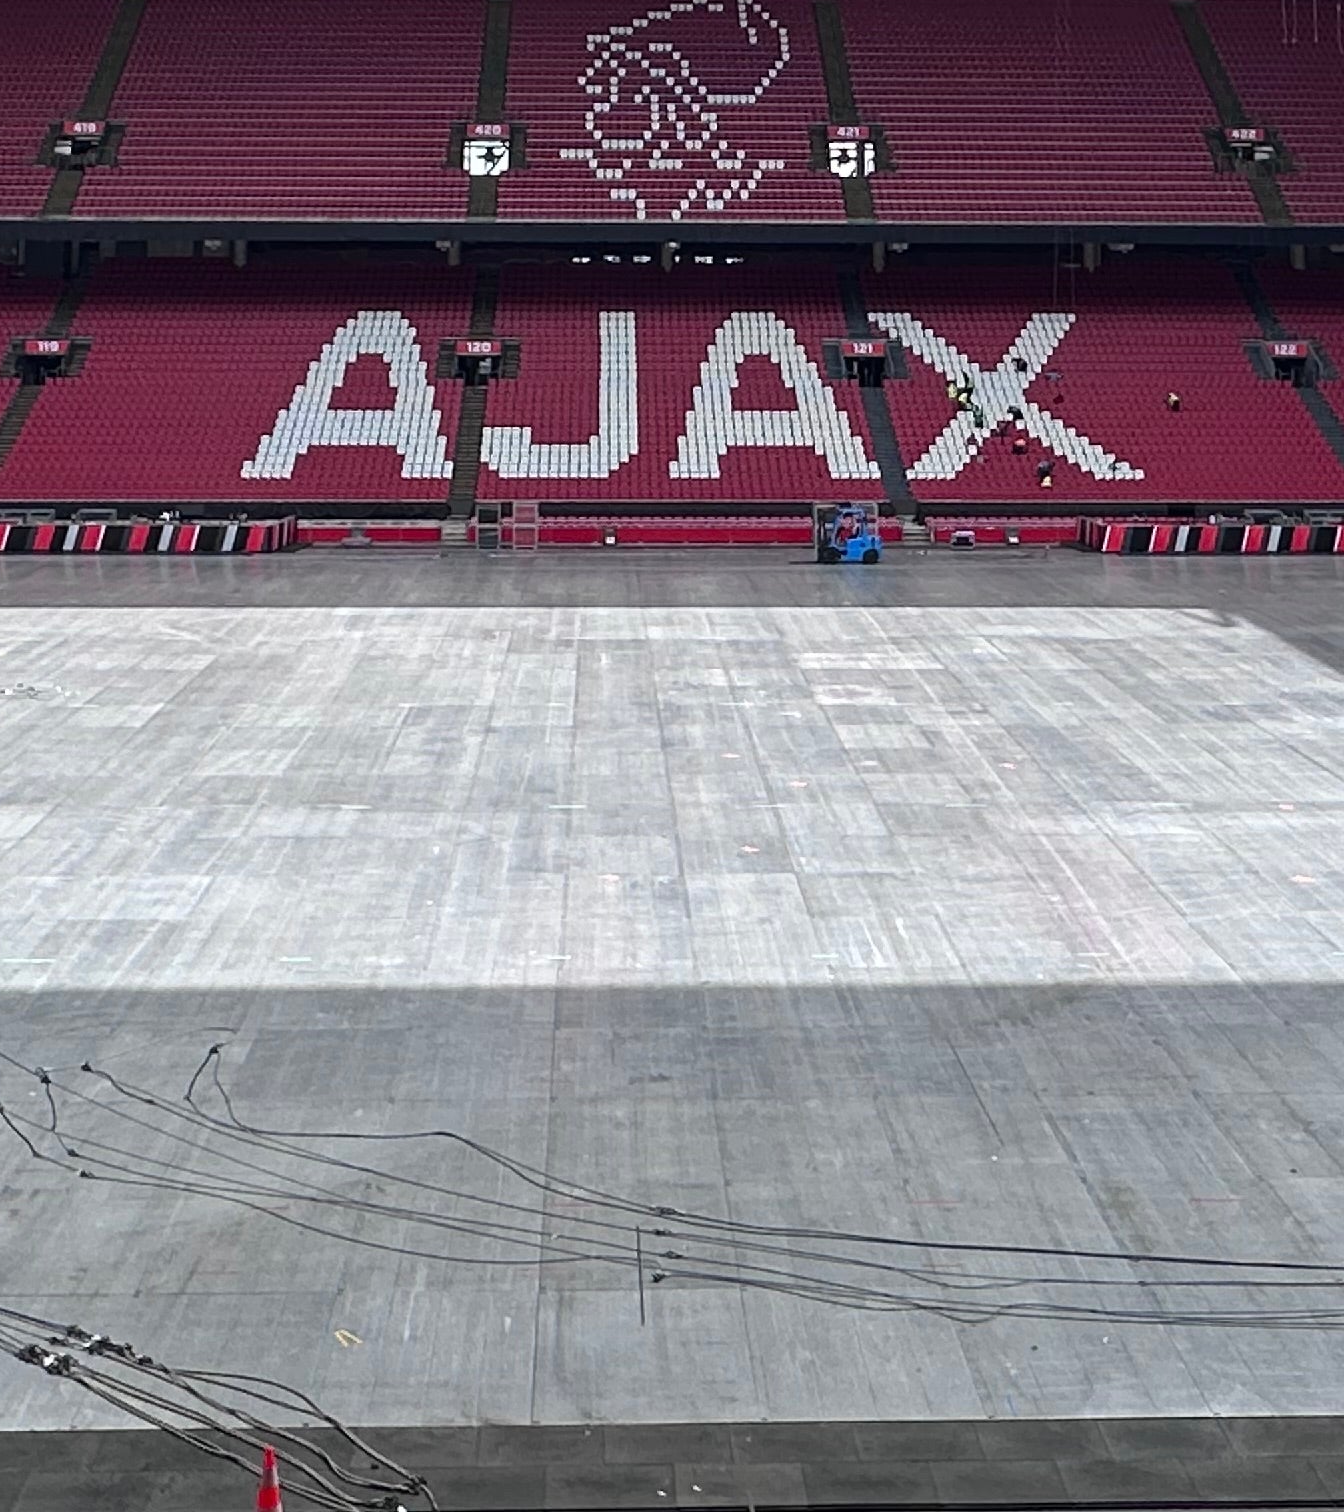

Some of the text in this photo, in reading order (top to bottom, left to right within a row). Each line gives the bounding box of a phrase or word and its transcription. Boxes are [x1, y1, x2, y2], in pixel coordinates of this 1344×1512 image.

[474, 124, 502, 136] 420
[836, 126, 860, 138] 421
[466, 342, 492, 353] 120
[852, 343, 874, 354] 121
[1274, 344, 1298, 355] 122
[240, 311, 1144, 481] AJAX
